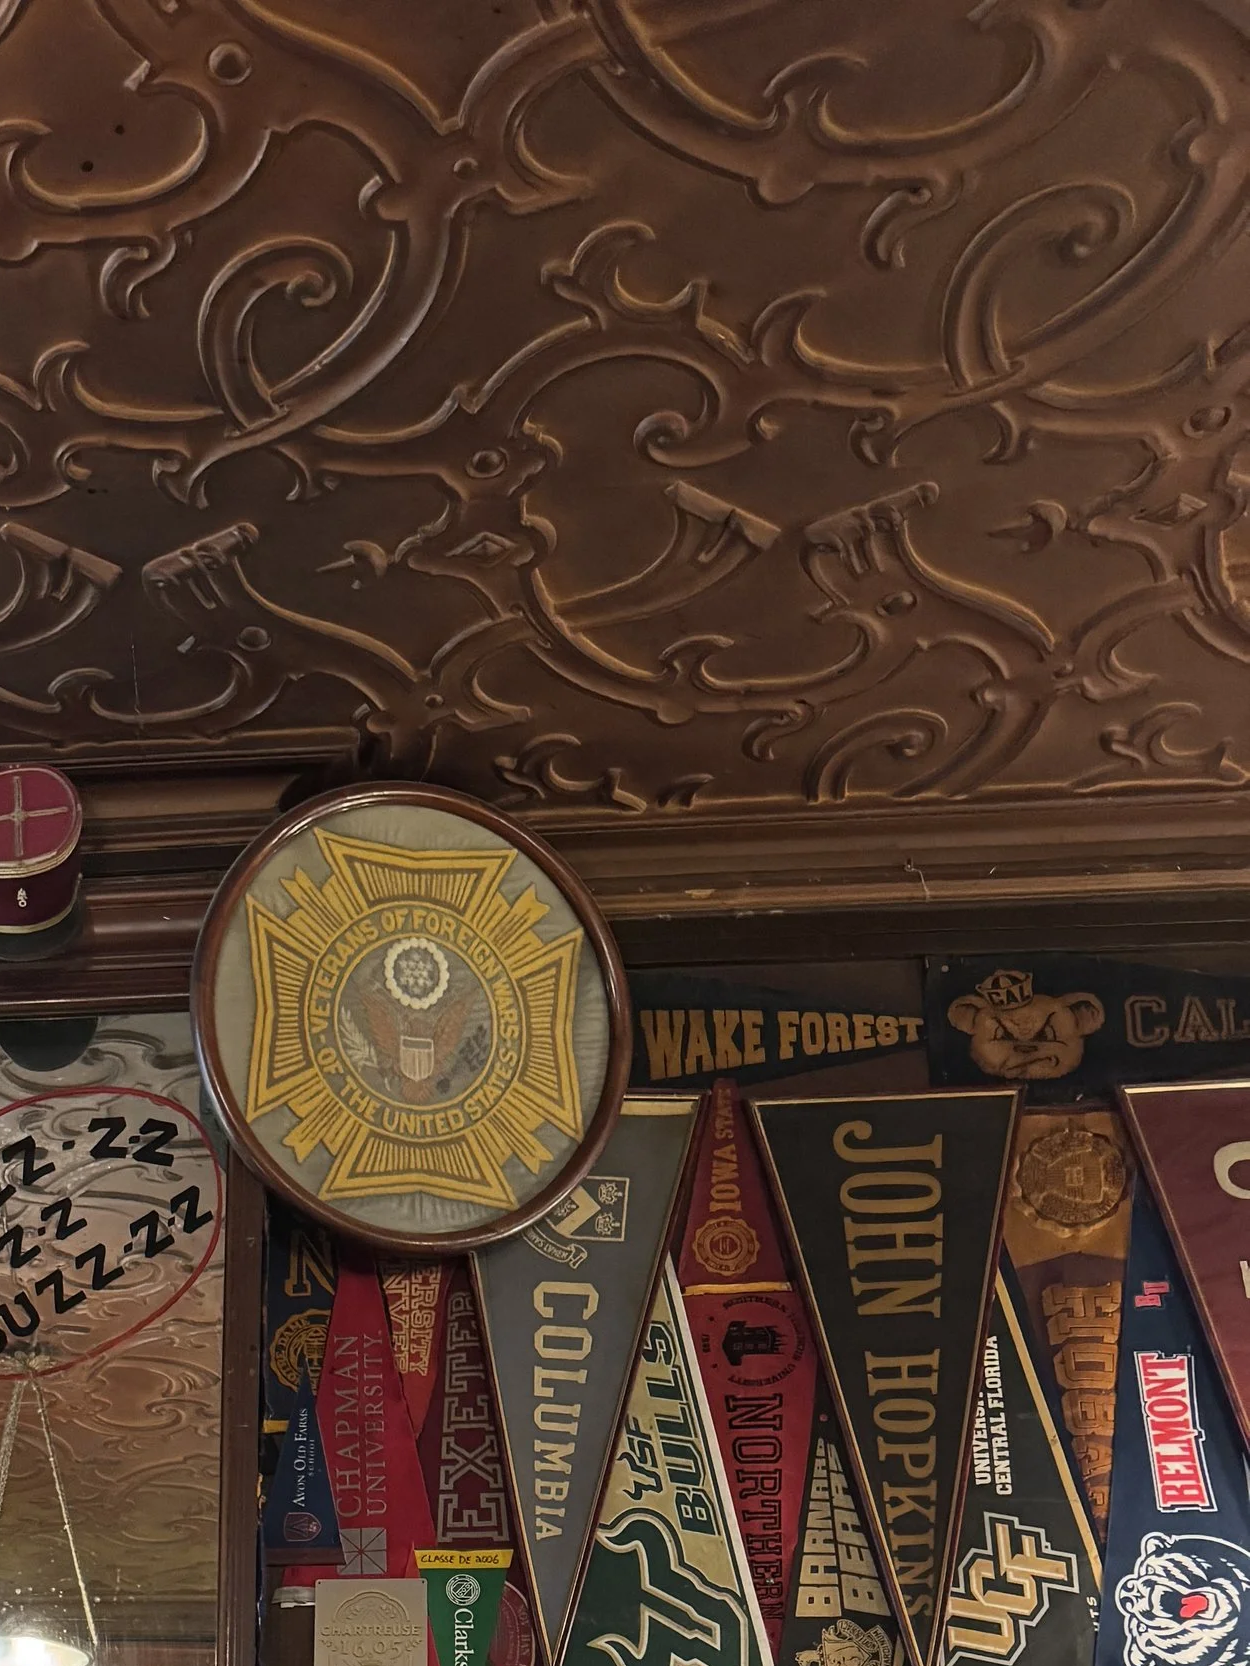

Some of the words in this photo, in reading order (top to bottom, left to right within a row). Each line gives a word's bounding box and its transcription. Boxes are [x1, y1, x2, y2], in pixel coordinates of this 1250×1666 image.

[311, 919, 379, 1034] VETERANS
[380, 909, 408, 932] OF
[412, 909, 501, 979] FOREIGN
[492, 979, 520, 1041] WARS
[316, 1047, 345, 1074] OF
[340, 1075, 382, 1122] THE
[383, 1107, 466, 1136] UNITED
[463, 1049, 518, 1121] STATES
[640, 1008, 767, 1081] WAKE
[777, 1011, 924, 1061] FOREST
[710, 1143, 743, 1212] IOWA
[833, 1119, 945, 1319] JOHN
[293, 1408, 308, 1441] FARMS
[334, 1335, 362, 1519] CHAPMAN
[533, 1281, 600, 1542] COLUMBIA
[642, 1320, 721, 1537] BULLS
[984, 1335, 1006, 1409] FLORIDA
[1138, 1350, 1210, 1508] BELMONT
[293, 1445, 307, 1471] OLD
[293, 1473, 307, 1508] AVON
[724, 1393, 784, 1621] NORTHERN
[862, 1348, 944, 1618] HOPKINS
[990, 1411, 1013, 1495] CENTRAL
[420, 1555, 455, 1564] CLASSE
[458, 1555, 471, 1565] DE
[795, 1437, 843, 1618] BARNARD
[826, 1442, 892, 1617] BEARS
[947, 1522, 1069, 1656] UCF
[320, 1624, 421, 1638] CHARTREUSE
